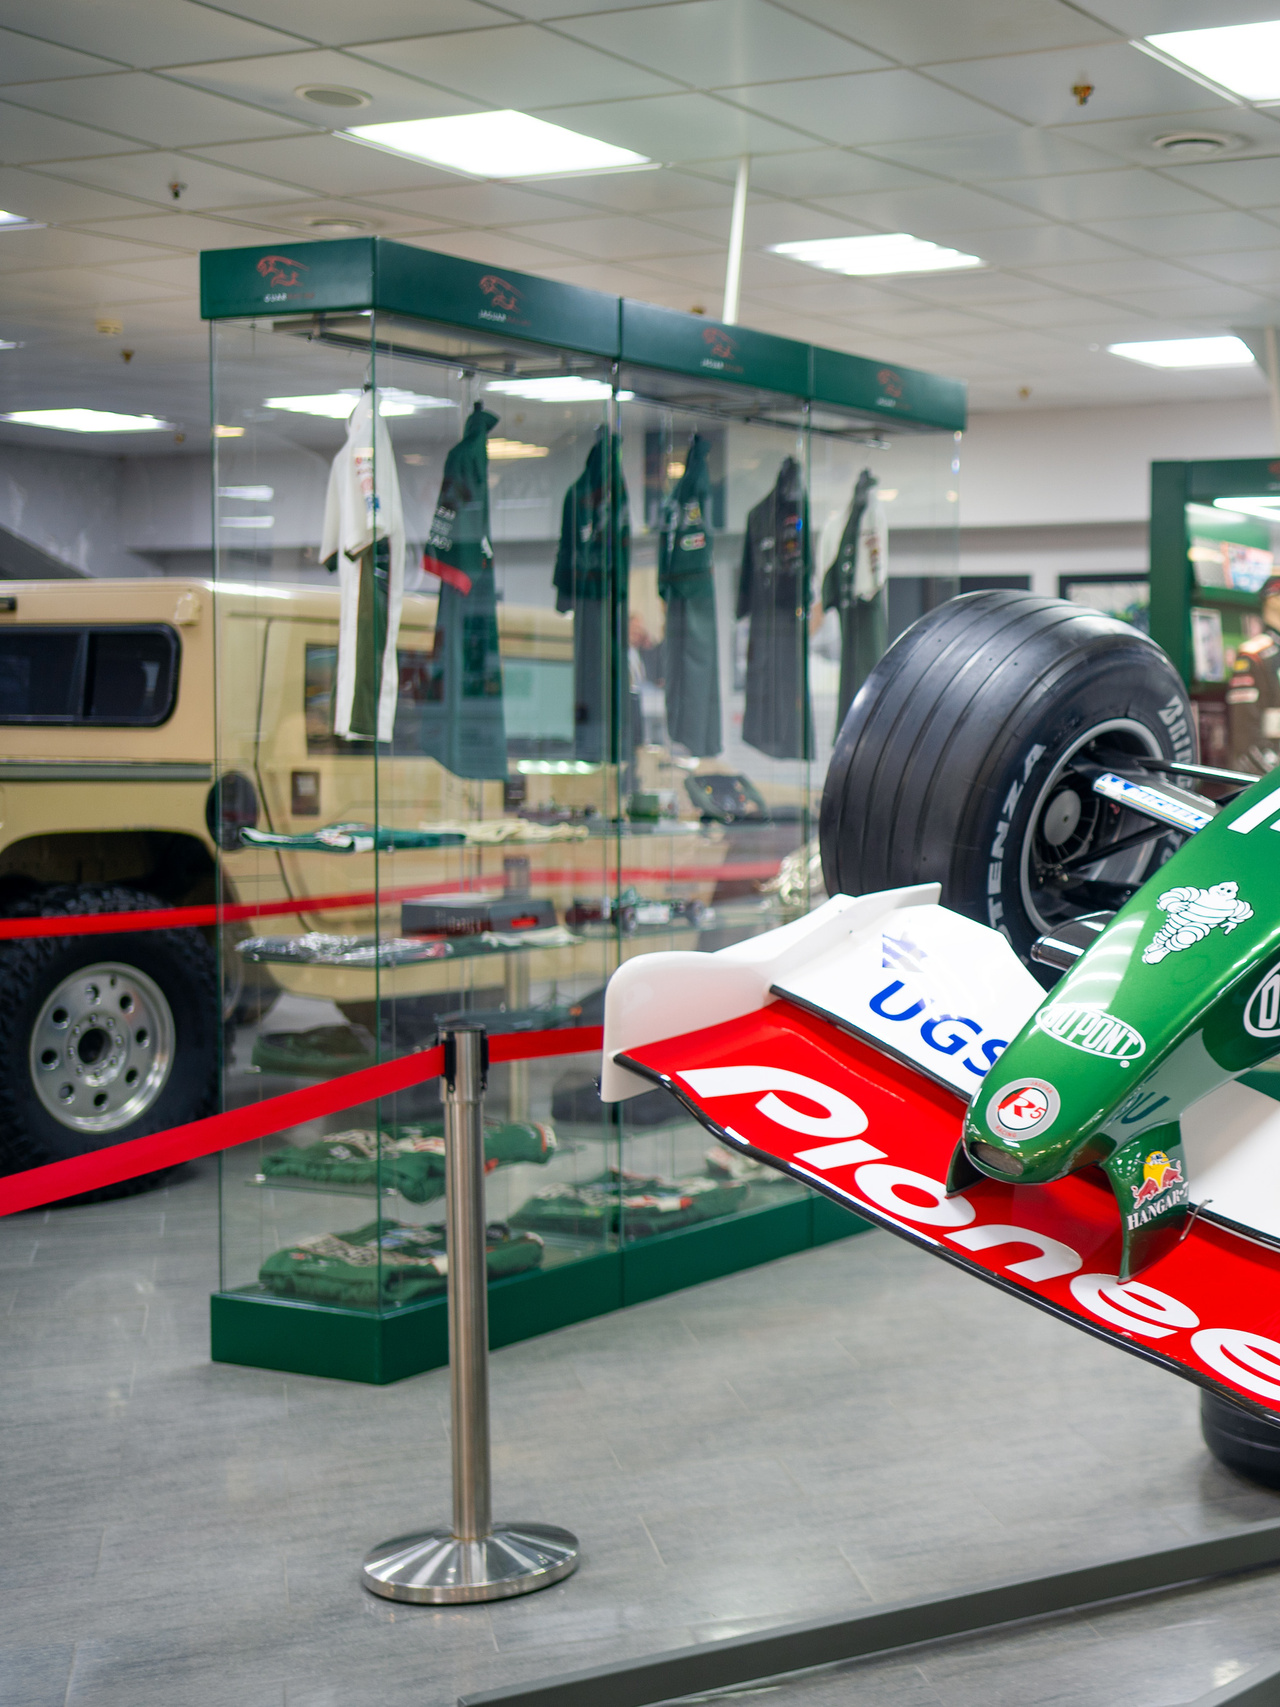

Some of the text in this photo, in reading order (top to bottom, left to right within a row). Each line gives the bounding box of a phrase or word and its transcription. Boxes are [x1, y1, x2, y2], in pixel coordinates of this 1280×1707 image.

[987, 743, 1047, 946] TENZA
[868, 979, 1009, 1078] UGS
[1127, 1181, 1190, 1231] HANGAR-7
